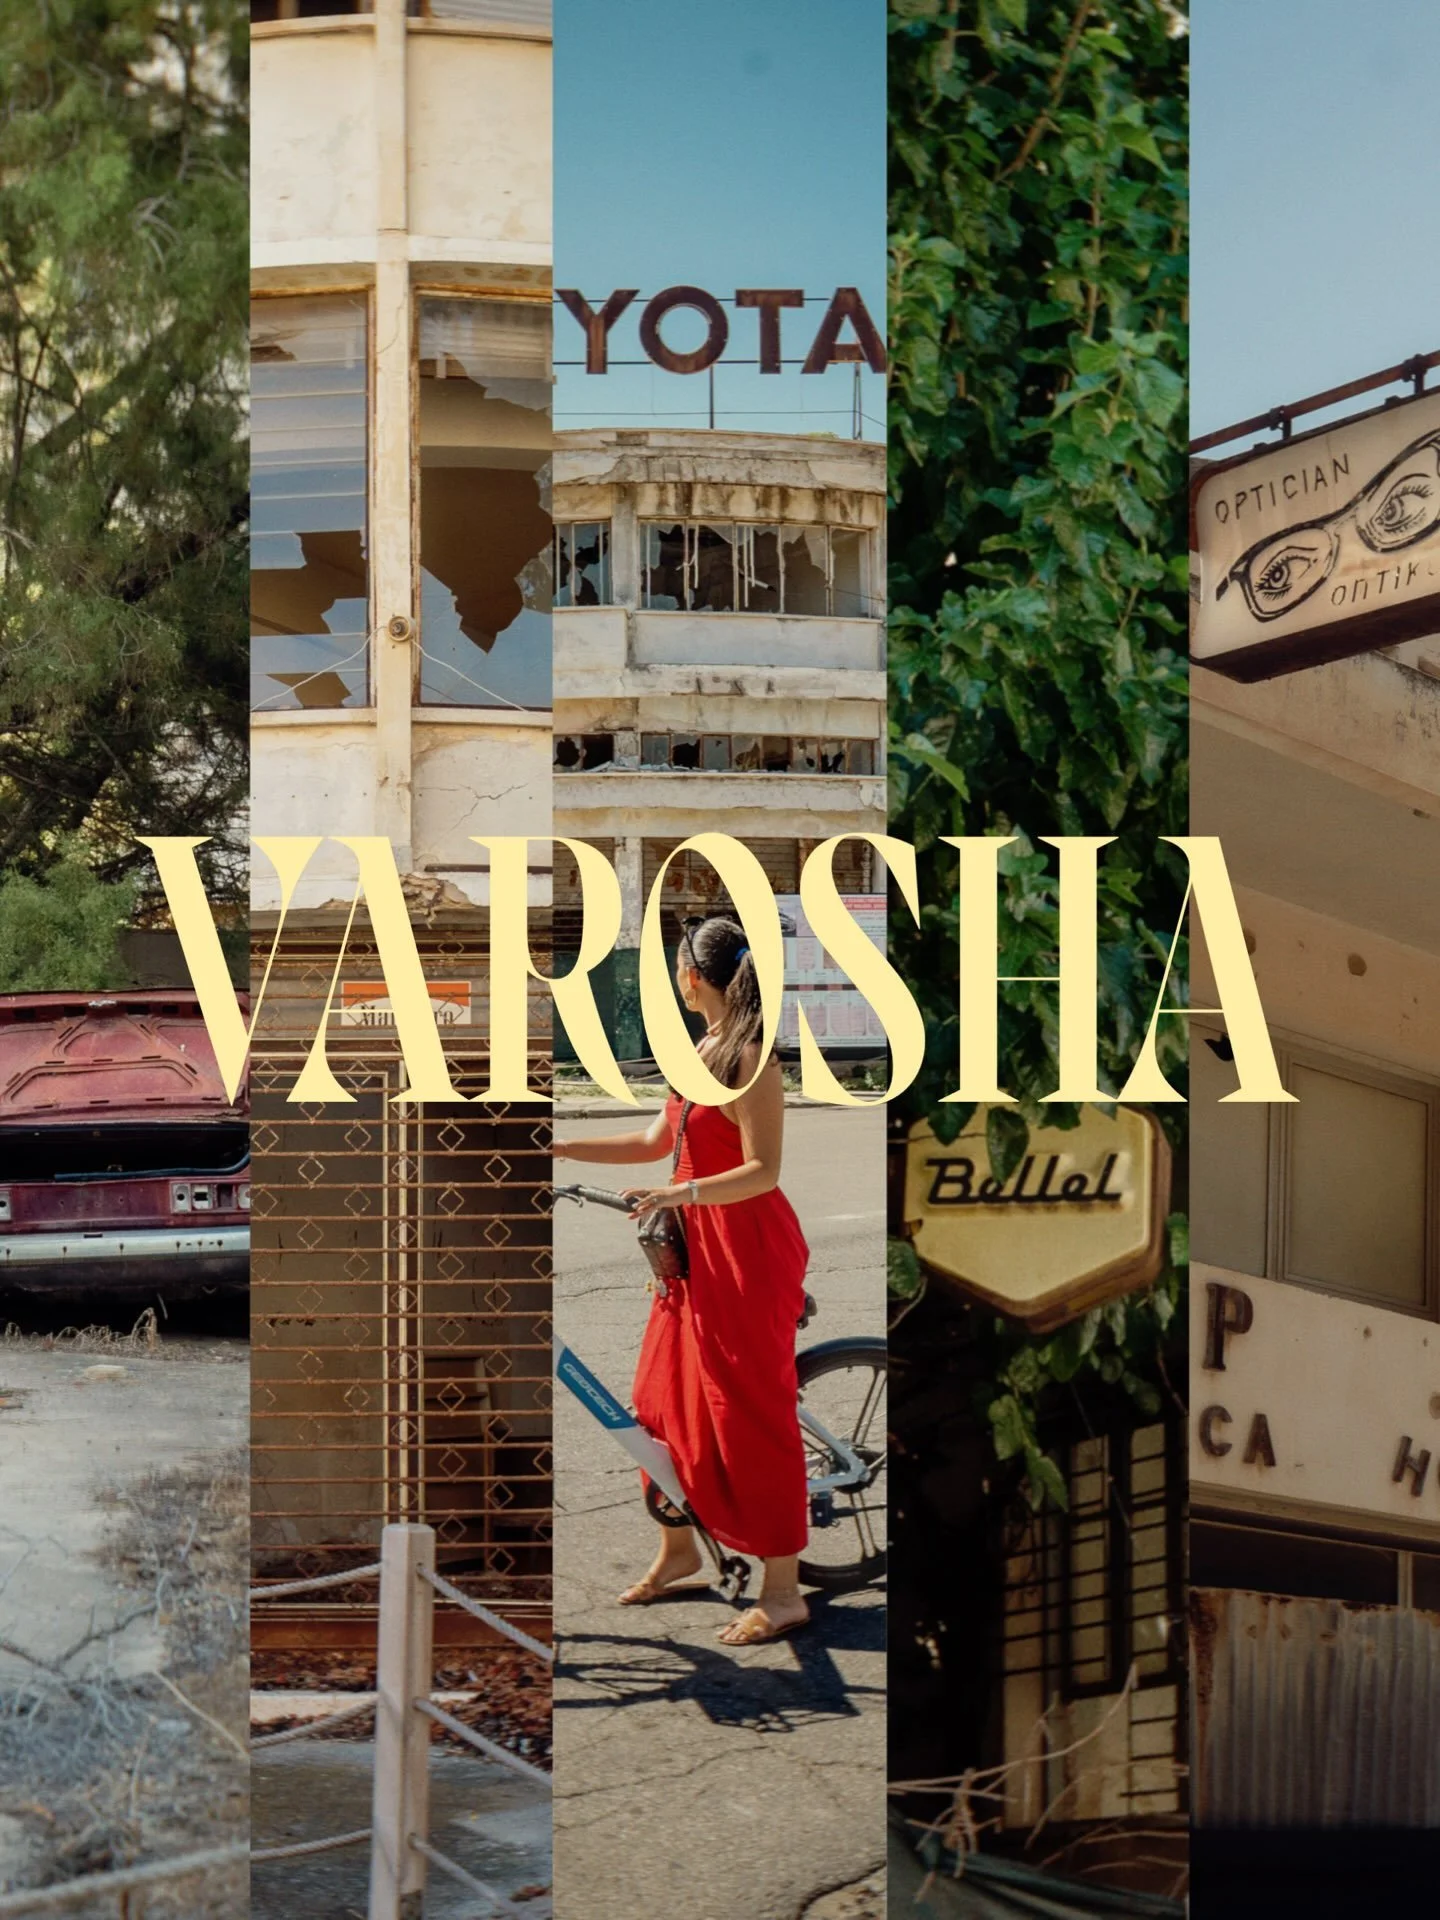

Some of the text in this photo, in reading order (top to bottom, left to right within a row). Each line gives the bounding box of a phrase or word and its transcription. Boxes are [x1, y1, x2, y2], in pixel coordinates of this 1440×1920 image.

[555, 285, 887, 374] YOTA
[1215, 453, 1350, 524] OPTICIAN
[1202, 1282, 1254, 1372] P
[1199, 1405, 1440, 1498] CA H
